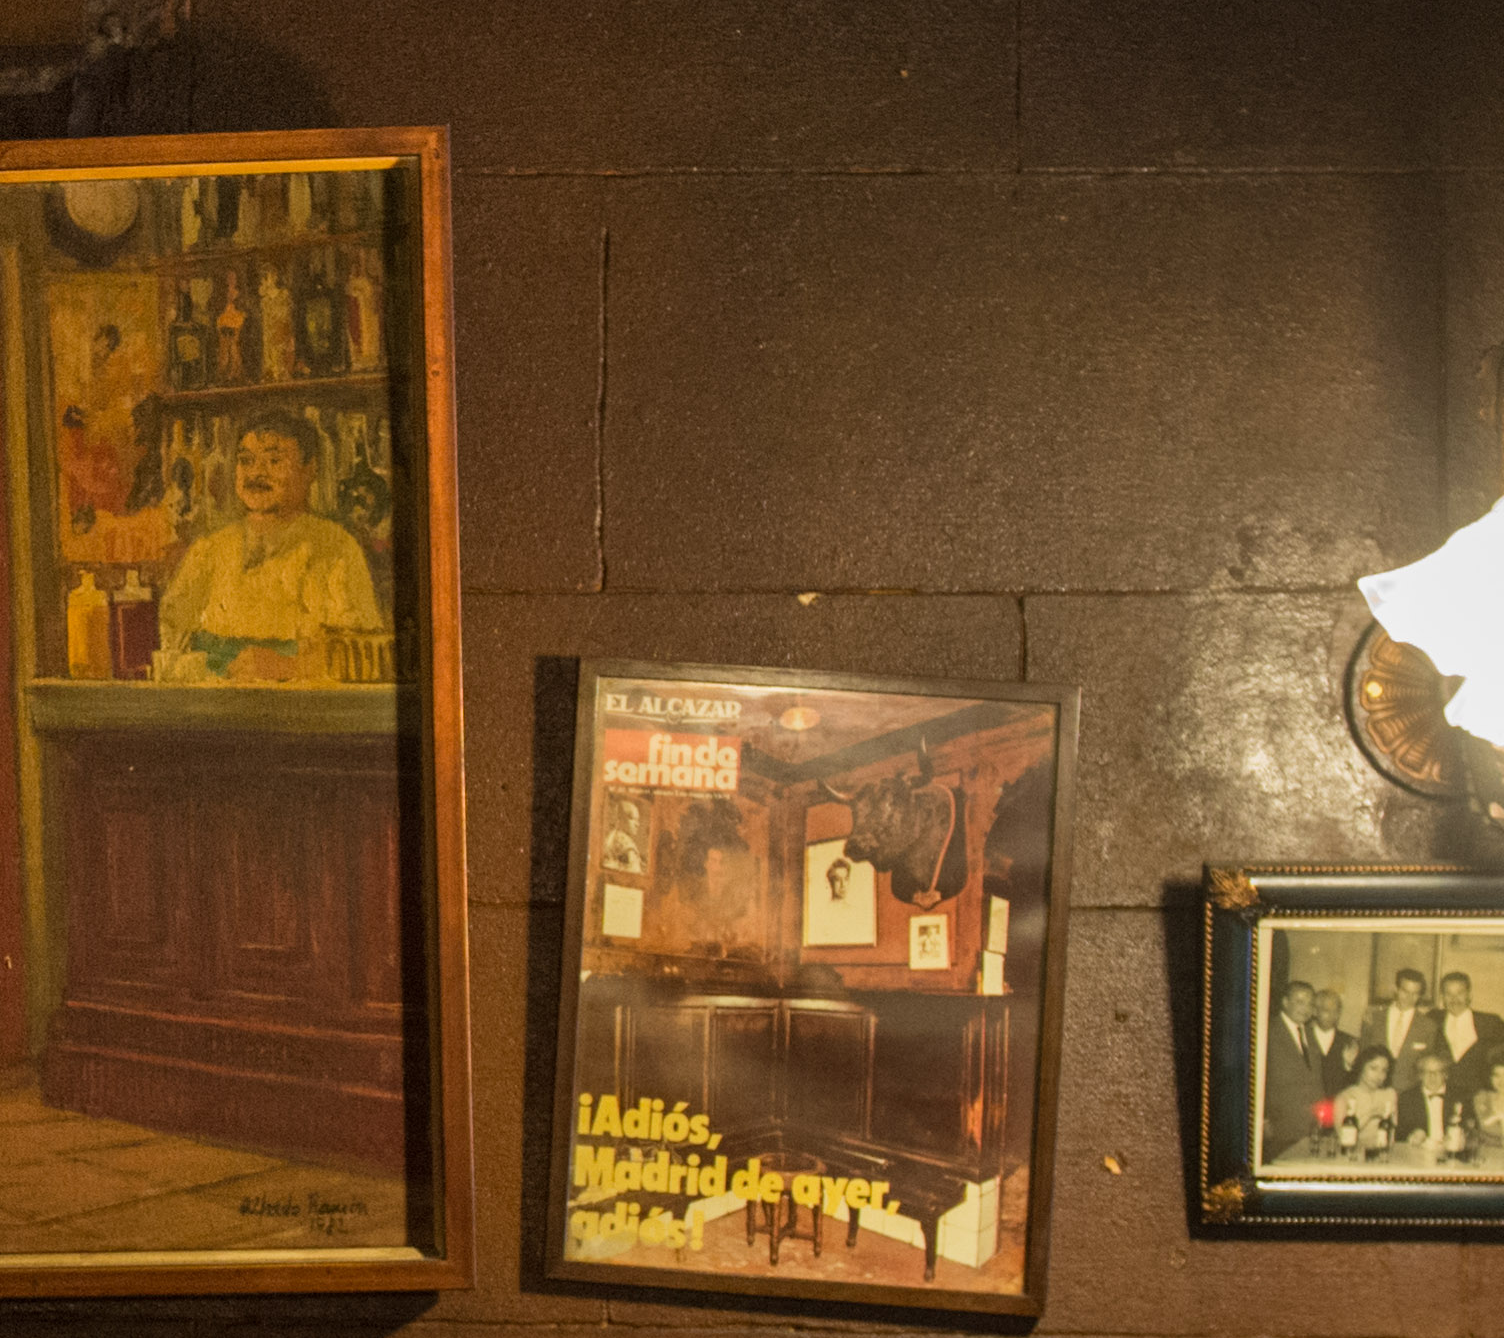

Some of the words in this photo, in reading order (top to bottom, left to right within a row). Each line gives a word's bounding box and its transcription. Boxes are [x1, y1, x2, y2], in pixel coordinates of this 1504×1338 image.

[606, 694, 633, 712] EL
[638, 696, 742, 719] ALCAZAR
[650, 733, 692, 766] fin
[695, 737, 738, 767] de
[604, 760, 737, 790] semana
[577, 1093, 723, 1150] ¡Adiós,
[574, 1145, 727, 1197] Madrid
[731, 1158, 784, 1202] de
[791, 1175, 900, 1216] ayer,
[570, 1202, 704, 1251] adiós!
